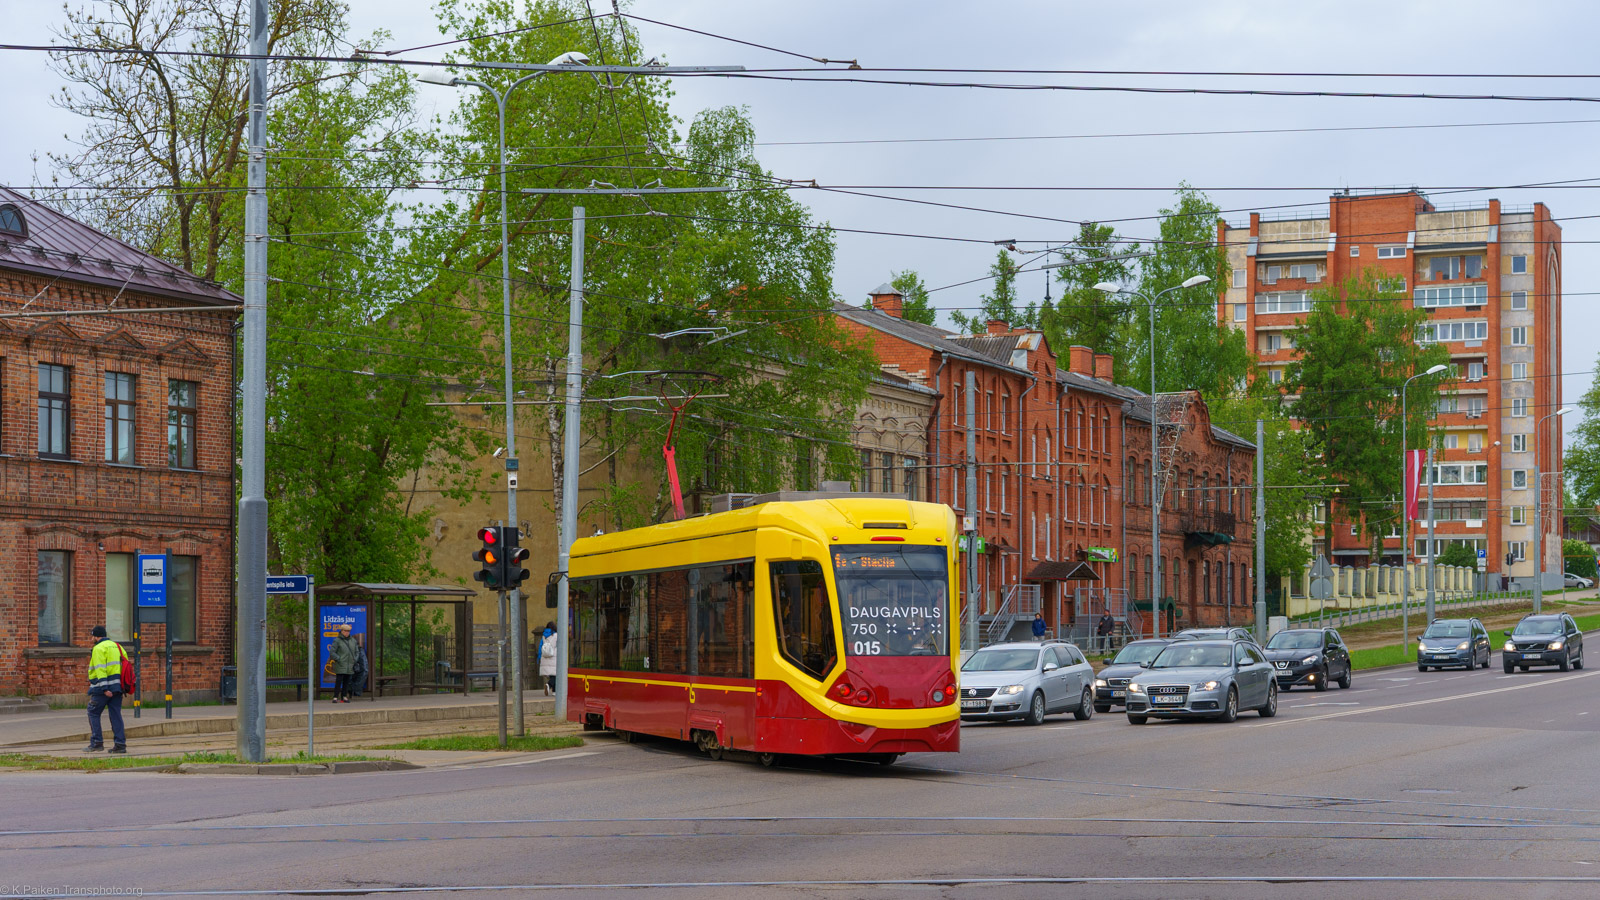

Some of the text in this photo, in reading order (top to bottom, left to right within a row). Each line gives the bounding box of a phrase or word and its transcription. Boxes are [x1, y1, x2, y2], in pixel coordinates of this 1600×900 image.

[266, 581, 286, 590] entspils
[850, 606, 941, 619] DAUGAVPILS
[323, 622, 332, 630] 15
[851, 623, 878, 635] 750
[854, 641, 881, 656] 015
